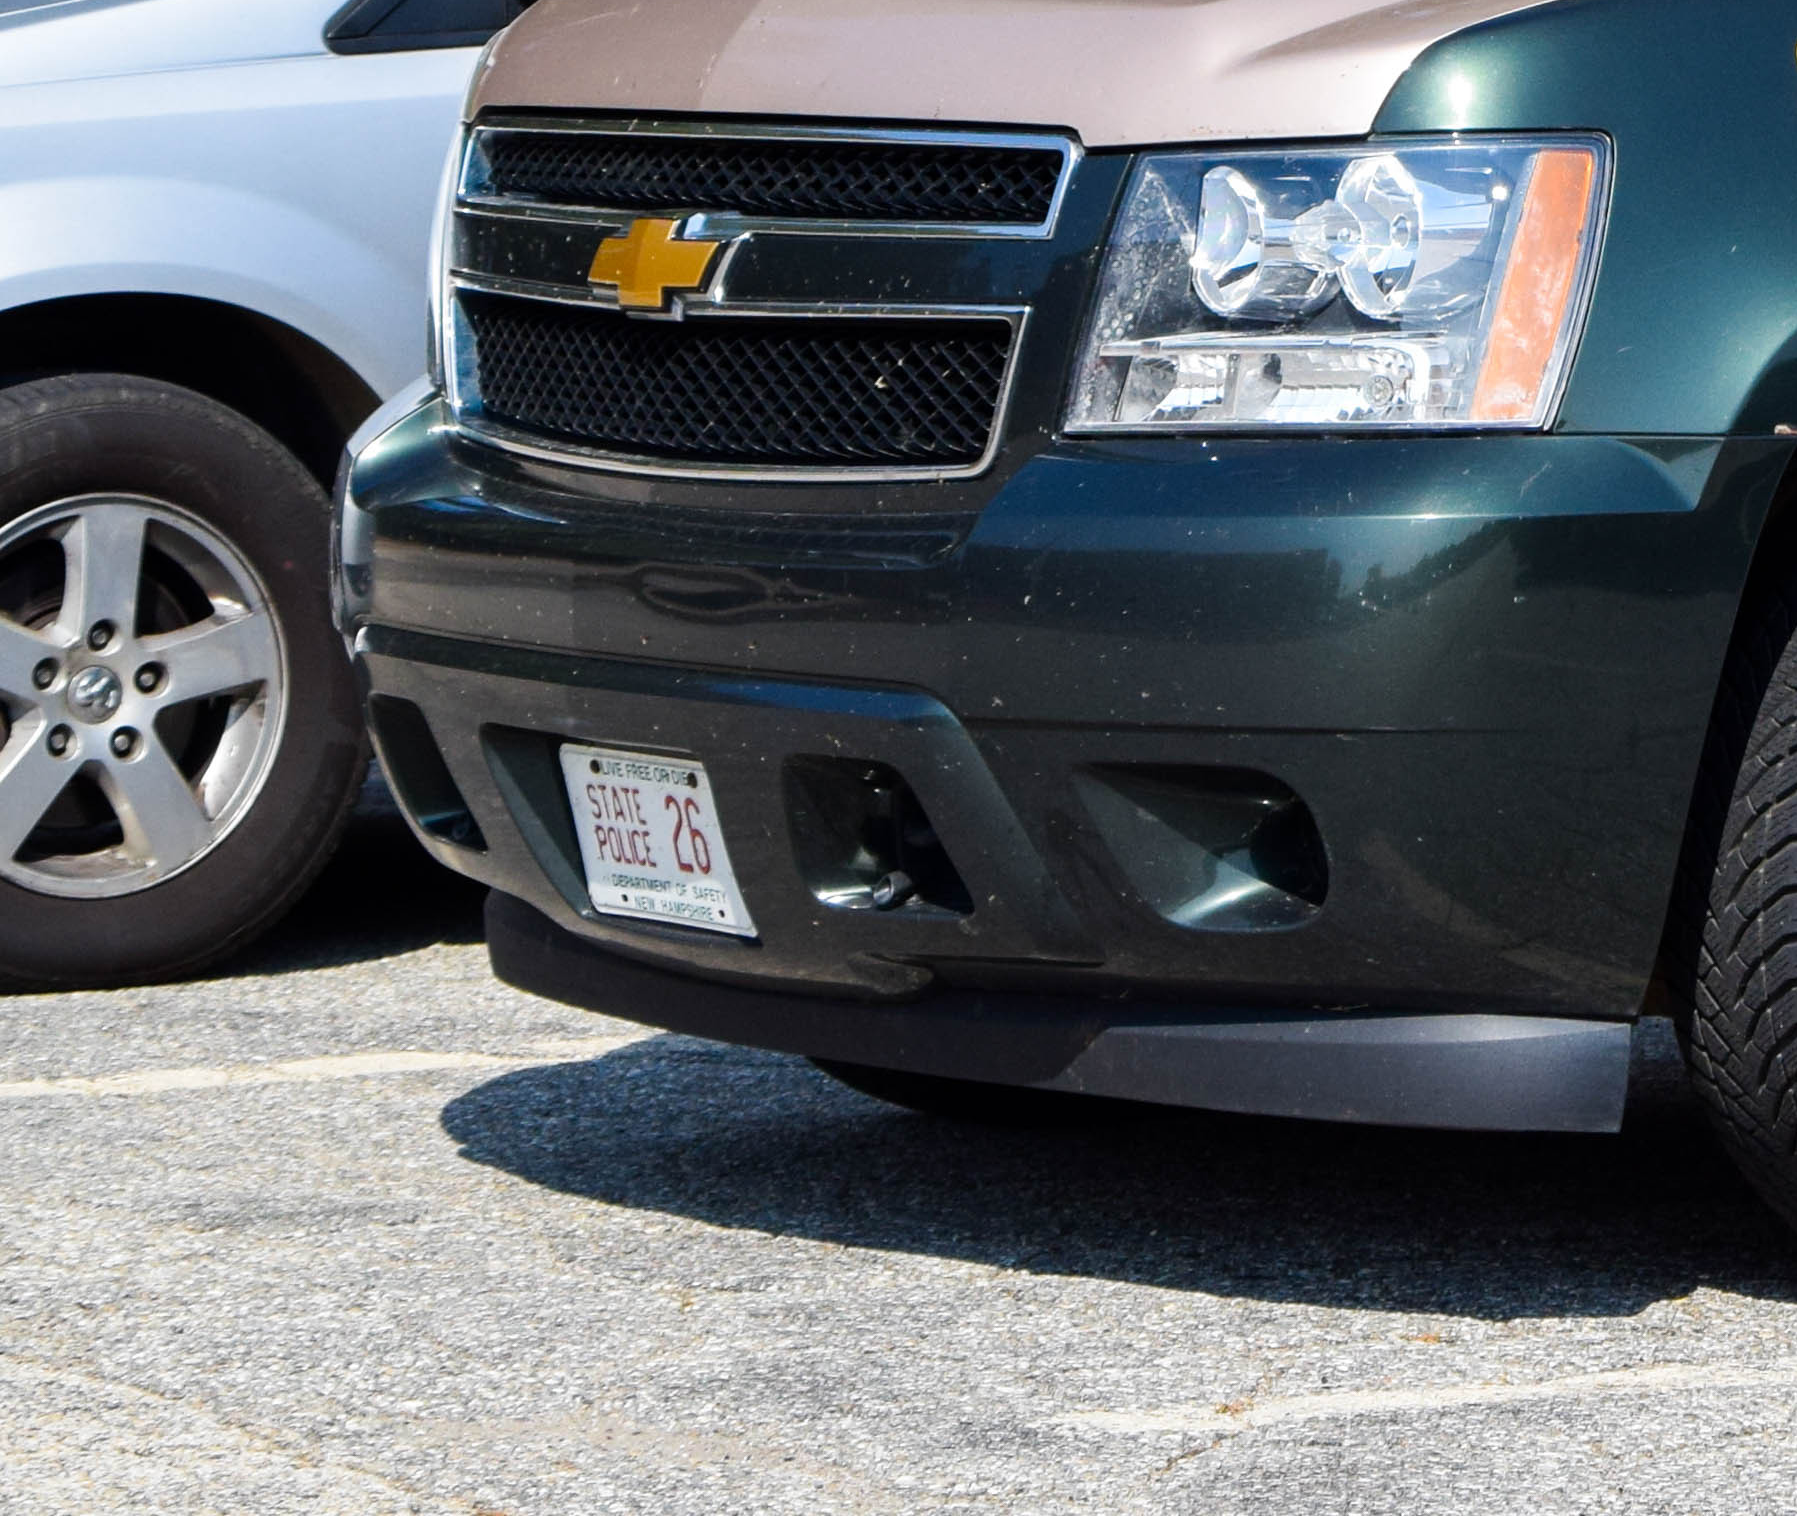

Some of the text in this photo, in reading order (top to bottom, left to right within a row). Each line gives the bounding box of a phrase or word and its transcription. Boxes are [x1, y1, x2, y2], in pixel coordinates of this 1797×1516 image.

[625, 764, 652, 781] FREE
[586, 784, 647, 825] STATE
[594, 825, 657, 868] POLICE
[664, 794, 711, 875] 26
